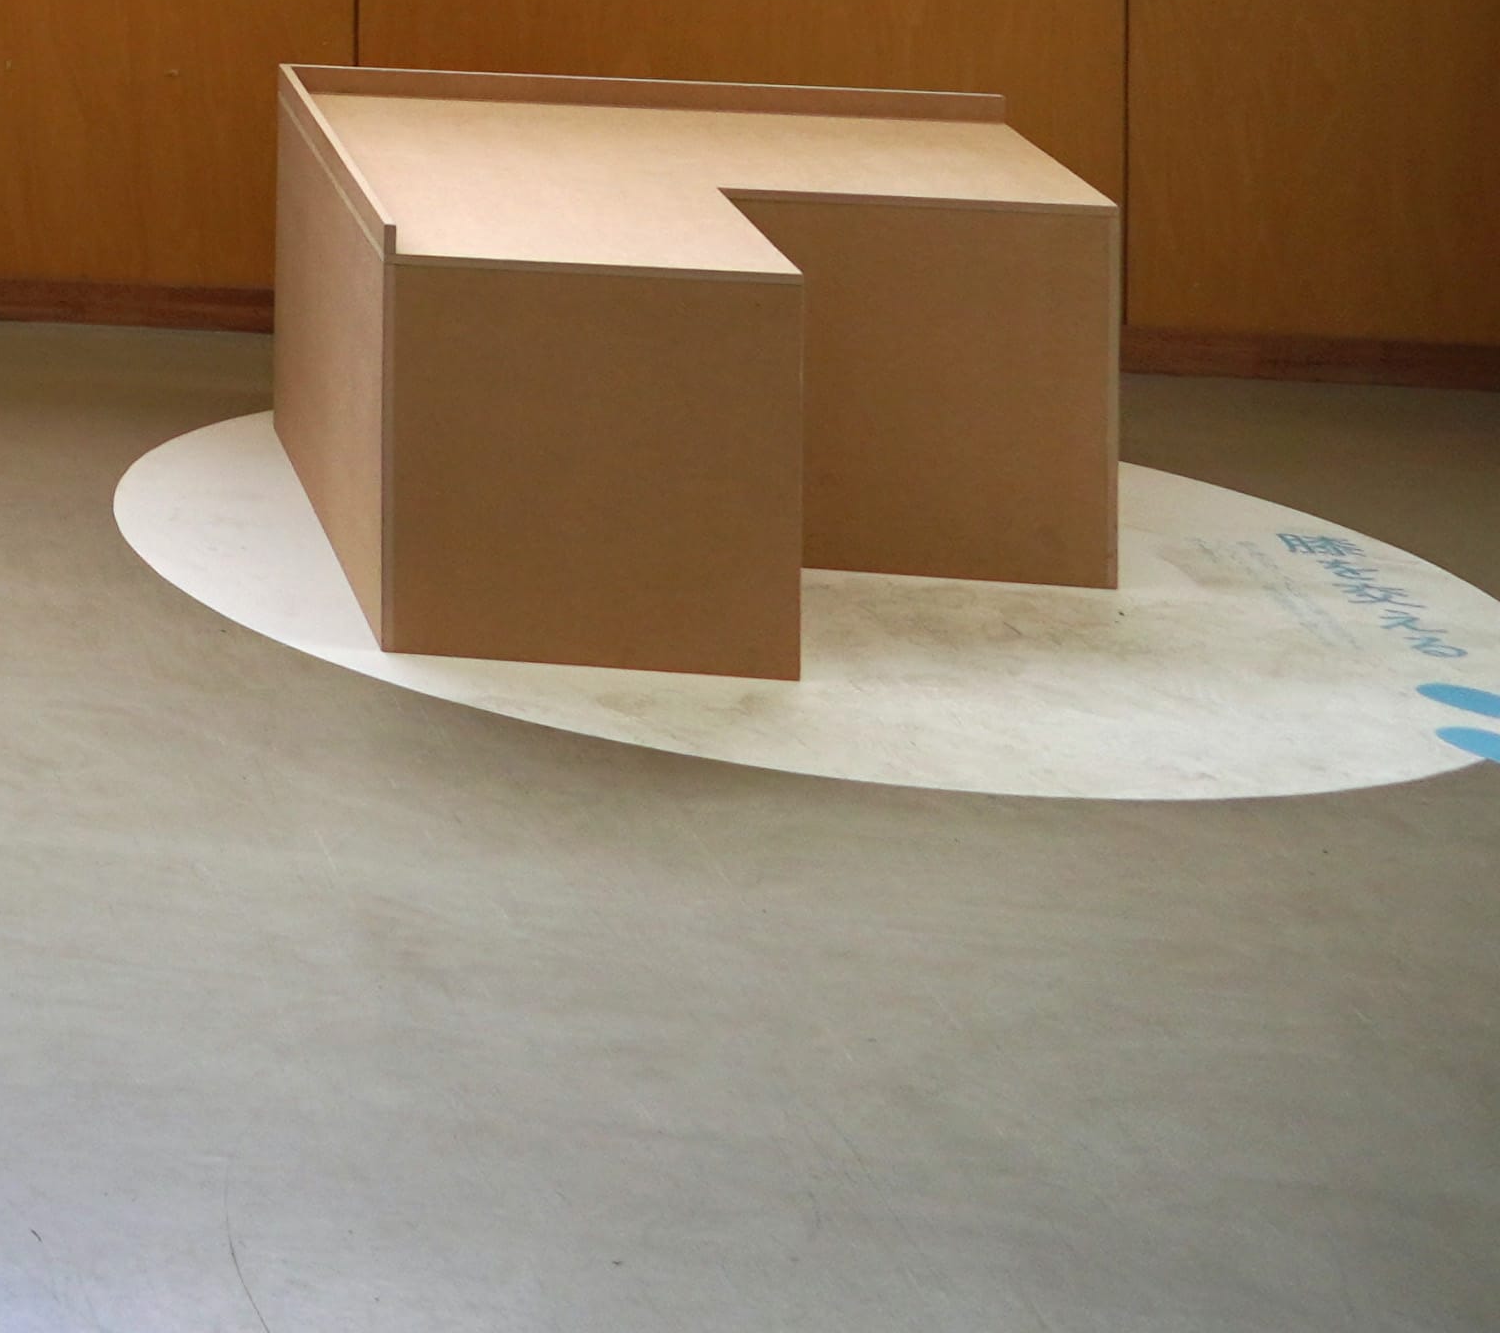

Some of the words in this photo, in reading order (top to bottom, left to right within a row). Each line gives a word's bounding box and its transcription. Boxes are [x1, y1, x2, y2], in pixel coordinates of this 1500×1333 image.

[1276, 532, 1469, 659] 膝を交える
